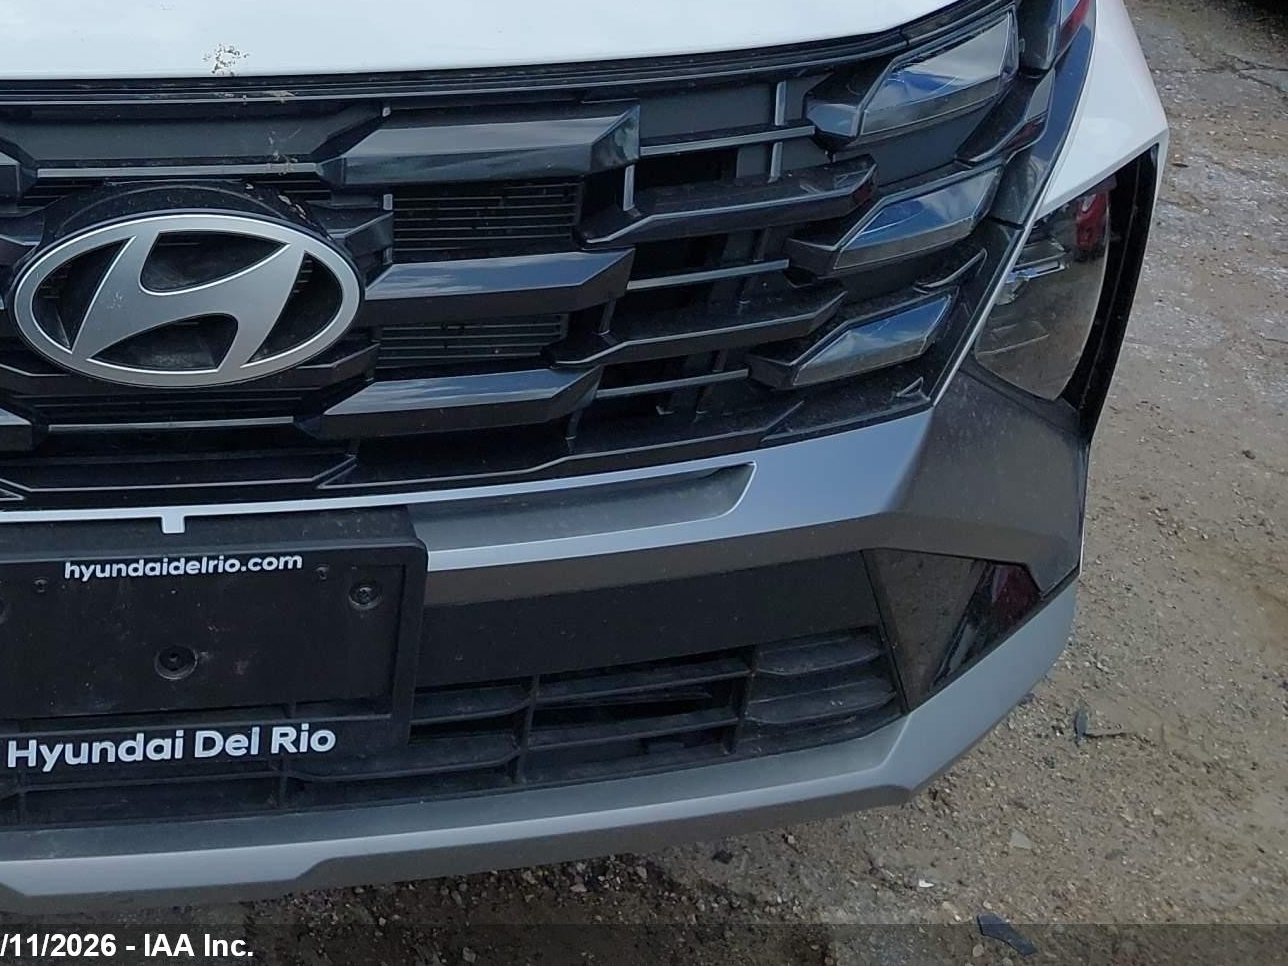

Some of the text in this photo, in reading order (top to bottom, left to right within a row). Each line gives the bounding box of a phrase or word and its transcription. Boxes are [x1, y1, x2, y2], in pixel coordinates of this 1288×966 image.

[64, 553, 303, 581] hyundaidelrio.com
[6, 723, 337, 773] Hyundai Del Rio
